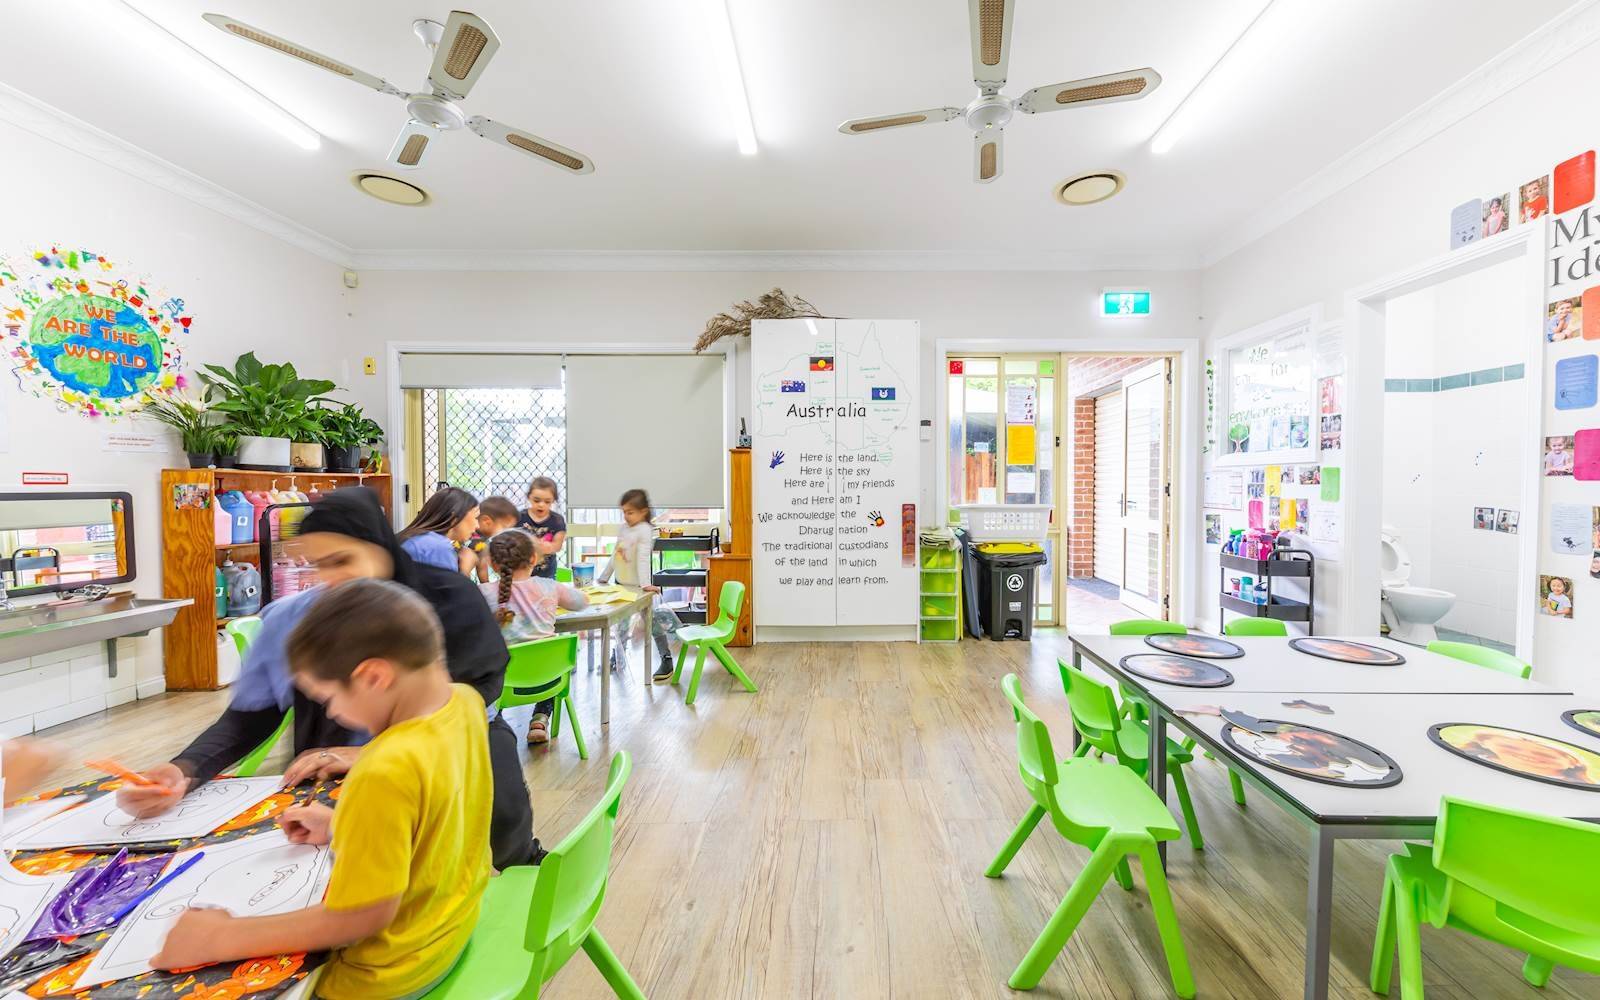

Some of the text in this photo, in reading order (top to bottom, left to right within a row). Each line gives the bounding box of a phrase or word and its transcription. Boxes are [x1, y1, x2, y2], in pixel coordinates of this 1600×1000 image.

[84, 304, 116, 323] WE
[44, 315, 138, 345] ARE THE
[64, 343, 147, 368] WORLD
[786, 402, 867, 418] Australia
[799, 452, 824, 463] Here
[825, 453, 833, 463] is
[837, 453, 854, 463] the
[857, 452, 880, 463] land.
[799, 465, 871, 478] Here is the sky
[784, 478, 895, 490] Here are my friends
[791, 494, 861, 506] and Here am I
[757, 509, 857, 523] We acknowledge the
[798, 525, 869, 537] Dharug nation
[761, 540, 889, 552] The traditional custodians
[774, 556, 877, 568] of the land in which
[778, 575, 889, 587] we play and learn from.
